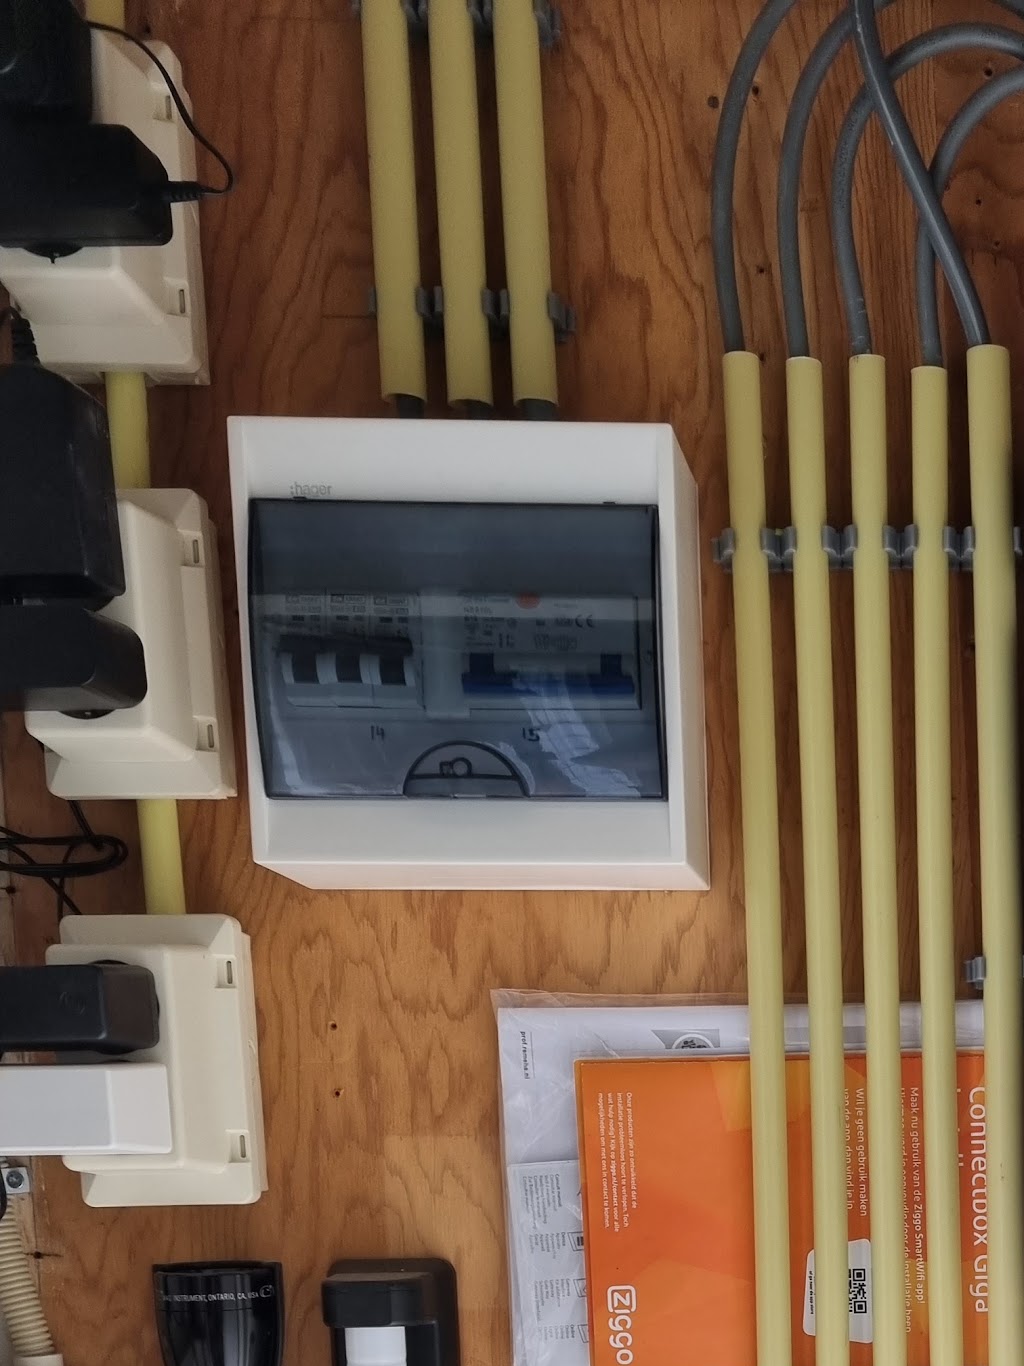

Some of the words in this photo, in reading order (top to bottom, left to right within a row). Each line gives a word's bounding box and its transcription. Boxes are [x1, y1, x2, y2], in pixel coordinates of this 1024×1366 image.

[371, 726, 385, 741] 14
[522, 727, 541, 741] 15
[855, 1088, 865, 1105] Wil
[910, 1088, 919, 1114] Maak
[597, 1093, 606, 1136] mogelijkheden
[854, 1107, 865, 1116] je
[608, 1119, 616, 1138] nodig?
[854, 1119, 865, 1142] geen
[911, 1116, 918, 1129] nu
[600, 1137, 606, 1146] om
[910, 1131, 921, 1168] gebruik
[610, 1151, 616, 1159] op
[855, 1145, 867, 1182] gebruik
[611, 1160, 619, 1206] ziggo.nl/contact
[859, 1184, 868, 1216] maken
[913, 1190, 922, 1201] de
[913, 1204, 923, 1231] Ziggo
[915, 1233, 925, 1281] SmartWifi
[207, 1293, 236, 1301] ONTARIO,
[916, 1283, 926, 1304] app!
